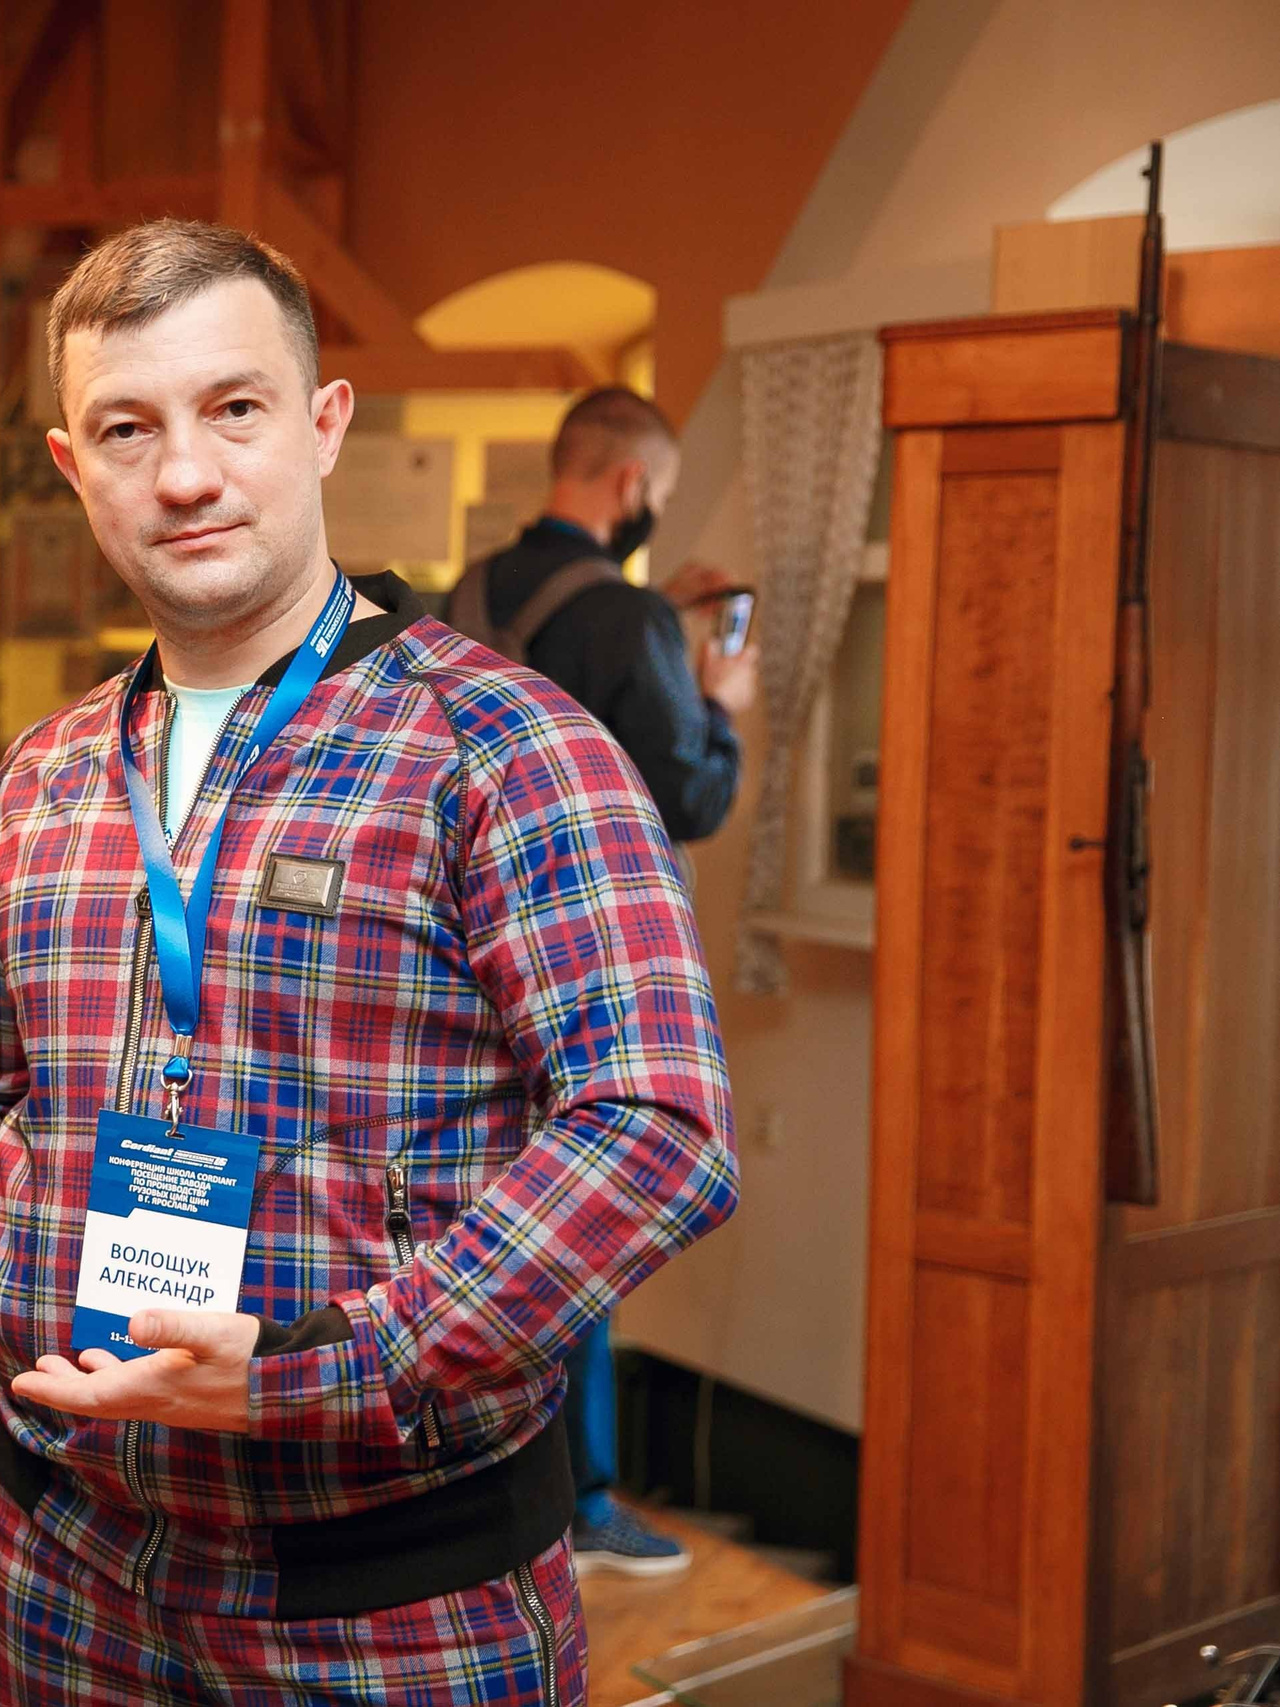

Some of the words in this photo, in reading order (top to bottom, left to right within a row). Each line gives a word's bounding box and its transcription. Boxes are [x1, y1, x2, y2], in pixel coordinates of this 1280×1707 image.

[120, 1139, 174, 1156] Cordiant
[109, 1155, 166, 1173] КОНФЕРЕНЦИЯ
[166, 1167, 196, 1179] ШКОЛА
[197, 1172, 238, 1187] CORDIANT
[131, 1168, 179, 1184] ПОСЕЩЕНИЕ
[179, 1178, 212, 1191] ЗАВОДА
[129, 1185, 168, 1199] ГРУЗОВЫХ
[189, 1196, 210, 1207] ШИН
[133, 1177, 145, 1186] ПО
[146, 1180, 207, 1197] ПРОИЗВОДСТВУ
[137, 1194, 144, 1202] В
[144, 1195, 151, 1204] Г.
[151, 1197, 198, 1213] ЯРОСЛАВЛЬ
[111, 1243, 210, 1278] ВОЛОЩУК
[99, 1267, 215, 1306] АЛЕКСАНДР
